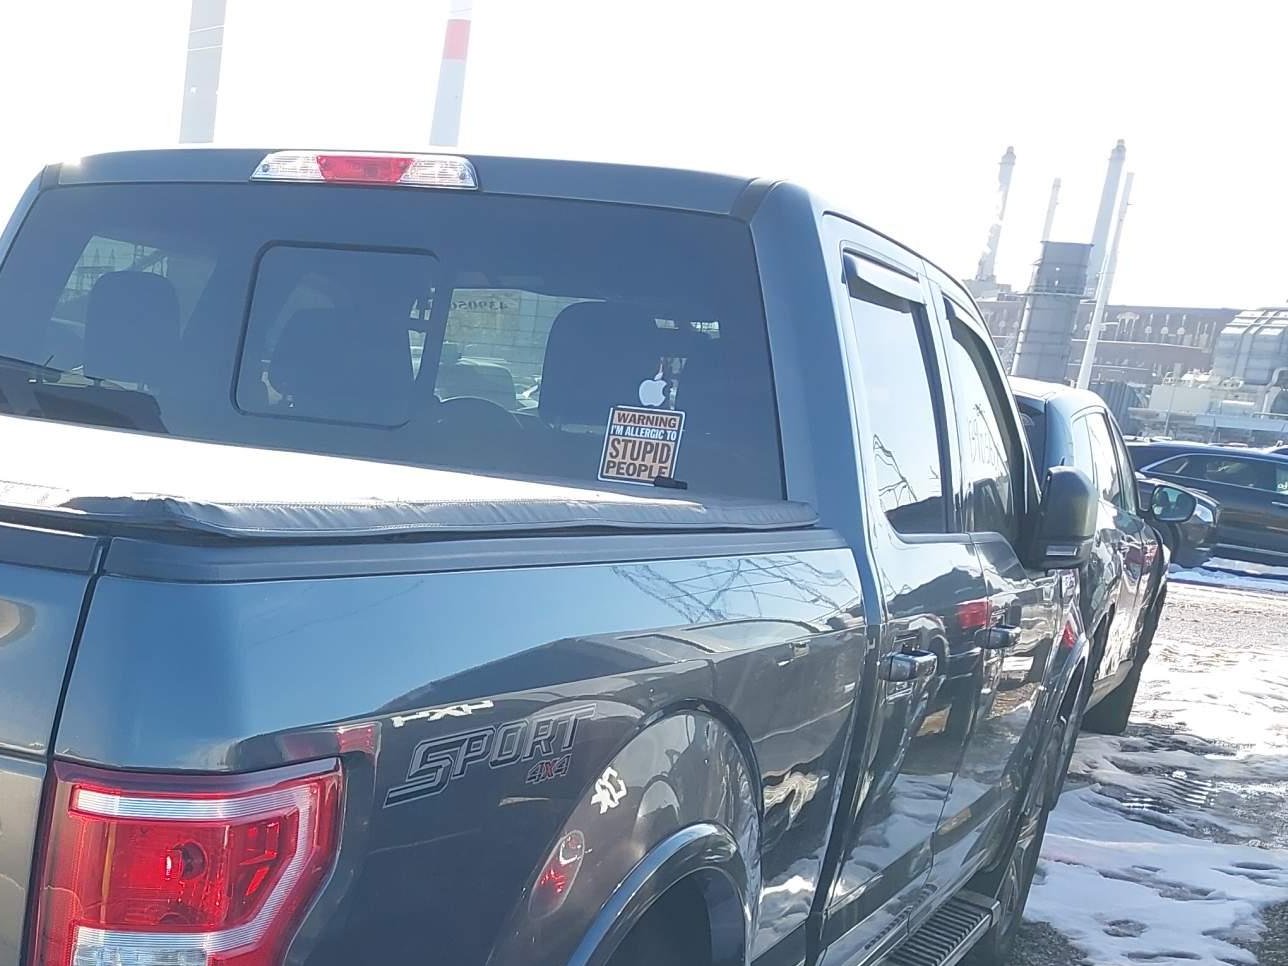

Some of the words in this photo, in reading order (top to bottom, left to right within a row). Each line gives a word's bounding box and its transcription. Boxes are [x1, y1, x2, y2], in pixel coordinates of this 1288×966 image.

[617, 412, 677, 428] WARNING
[610, 424, 624, 436] I'M
[624, 426, 664, 440] ALLERGIC
[666, 430, 677, 441] TO
[608, 437, 672, 464] STUPID
[605, 460, 668, 479] PEOPLE
[382, 703, 597, 809] SPORT
